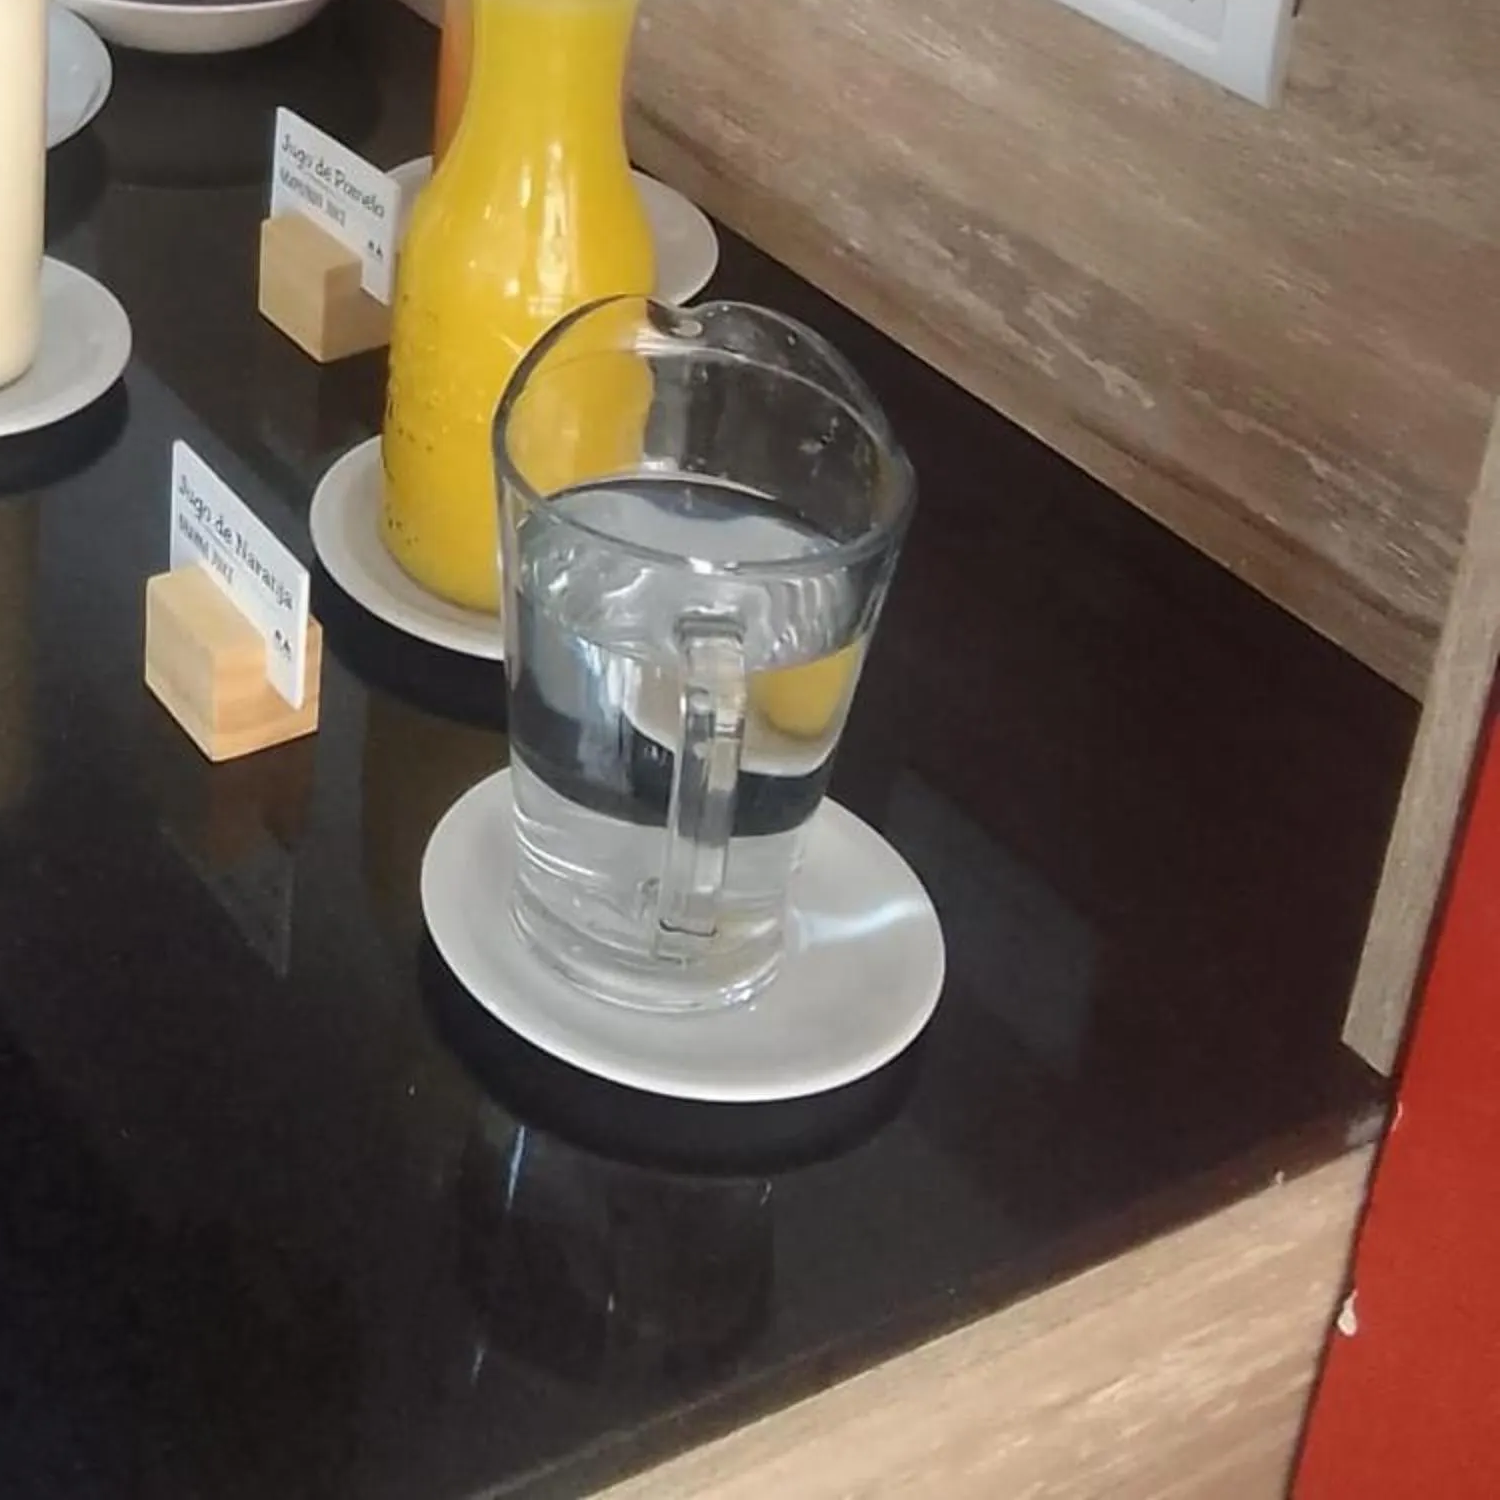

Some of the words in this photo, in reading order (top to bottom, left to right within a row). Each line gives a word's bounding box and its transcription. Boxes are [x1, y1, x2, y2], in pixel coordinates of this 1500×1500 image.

[315, 156, 333, 182] de
[179, 474, 213, 522] Jugo
[215, 514, 233, 543] de
[235, 531, 293, 611] Naranja
